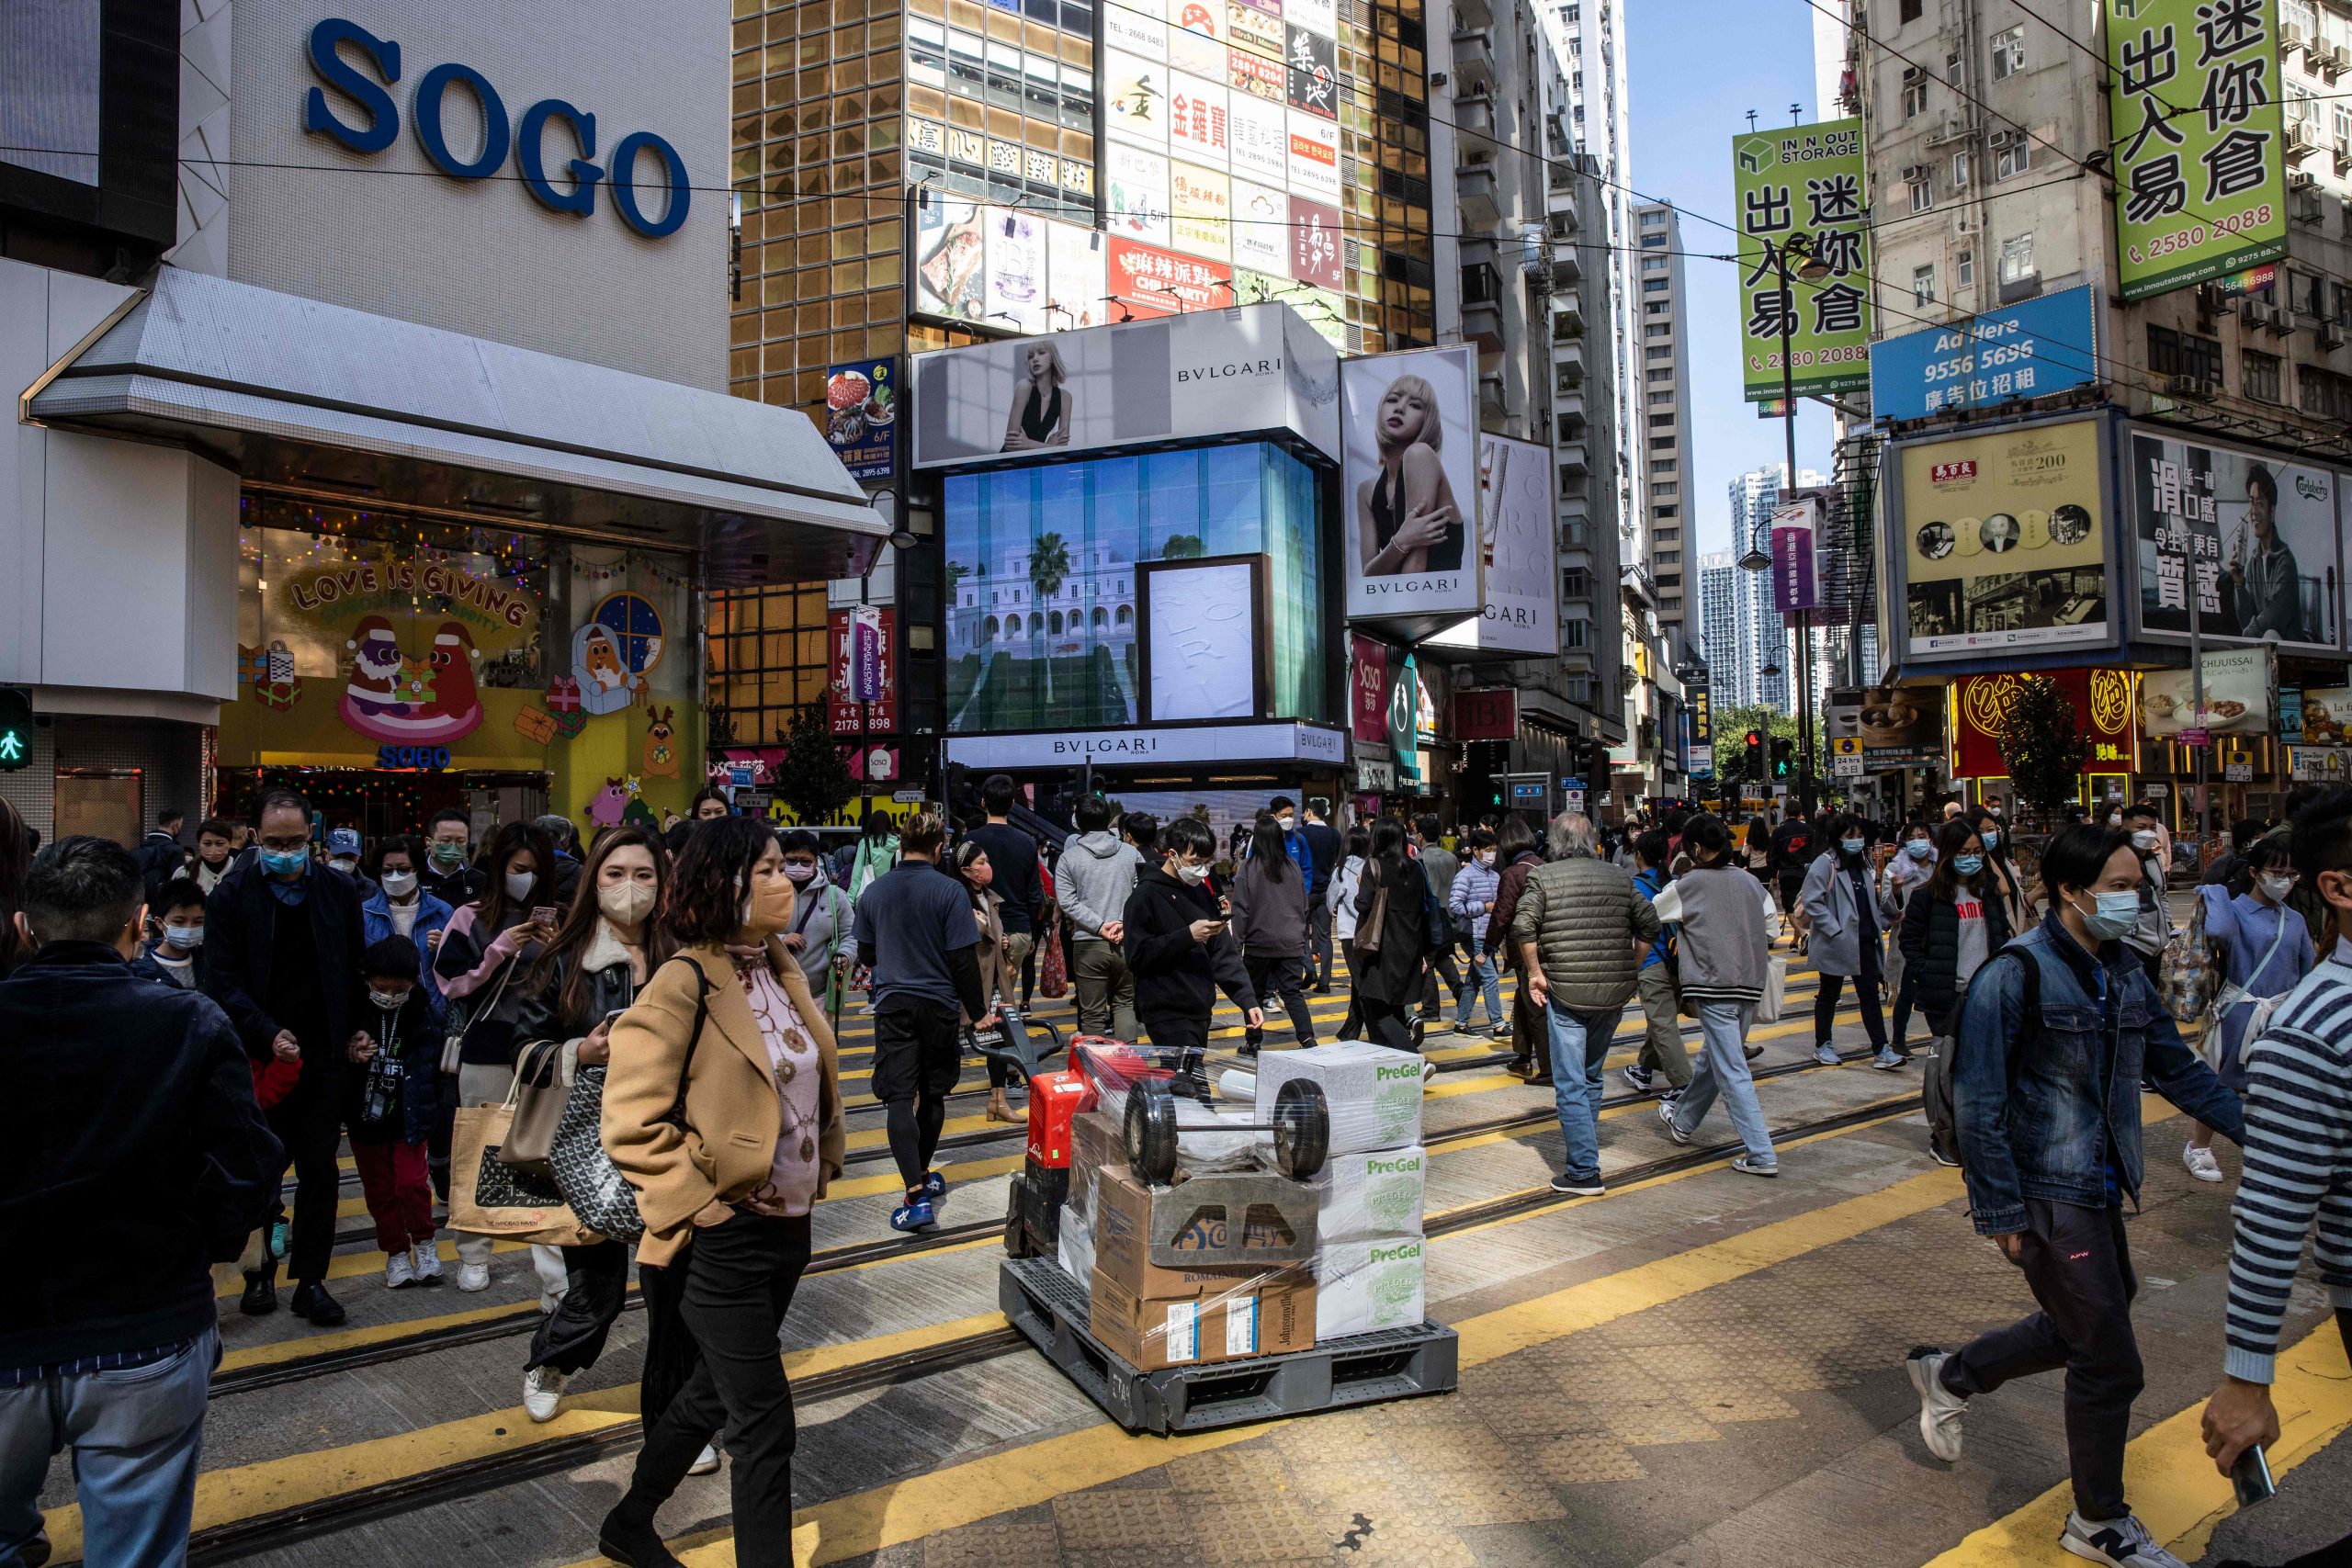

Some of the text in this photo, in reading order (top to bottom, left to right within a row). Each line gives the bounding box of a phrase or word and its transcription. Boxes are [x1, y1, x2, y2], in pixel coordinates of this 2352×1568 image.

[2197, 0, 2273, 202] 迷你倉
[308, 17, 691, 238] SOGO
[1806, 136, 1816, 147] N
[1826, 130, 1858, 144] OUT
[1781, 142, 1860, 164] STORAGE
[2150, 204, 2272, 258] 2580 2088
[1807, 175, 1866, 335] 迷你倉
[2237, 252, 2258, 264] 9275
[2224, 271, 2274, 292] 5649 6988
[1933, 319, 2019, 354] Ad Here
[1819, 345, 1865, 364] 2088
[1924, 339, 2034, 383] 9556 5696
[1177, 357, 1282, 383] BVLGARI
[1747, 383, 1823, 397] www.innoutrage.com
[1925, 367, 2035, 412] 廣告位招租
[874, 431, 890, 442] 6/F
[1935, 462, 1972, 478] 馬百良
[2036, 454, 2065, 469] 200
[2151, 457, 2181, 515] 滑
[2296, 474, 2328, 502] Carlsberg
[2184, 493, 2216, 524] 口感
[1787, 532, 1799, 605] 香港亞洲國際都會
[291, 567, 378, 610] LOVE
[385, 564, 415, 591] IS
[422, 565, 529, 629] GIVING
[1365, 579, 1458, 595] BVLGARI
[1483, 604, 1536, 625] GARI
[835, 719, 859, 731] 2178
[1697, 693, 1708, 739] IKEA
[1054, 738, 1157, 754] BVLGARI
[1300, 733, 1337, 750] BVLGARI
[379, 746, 451, 768] SOGO
[870, 757, 888, 767] Sasa
[1840, 765, 1858, 774] 全日
[1376, 1063, 1420, 1081] PreGel
[1367, 1156, 1420, 1174] PreGel
[1370, 1244, 1420, 1263] PreGel
[1184, 1270, 1236, 1283] ROMAINE
[1279, 1292, 1292, 1346] Johnsonville
